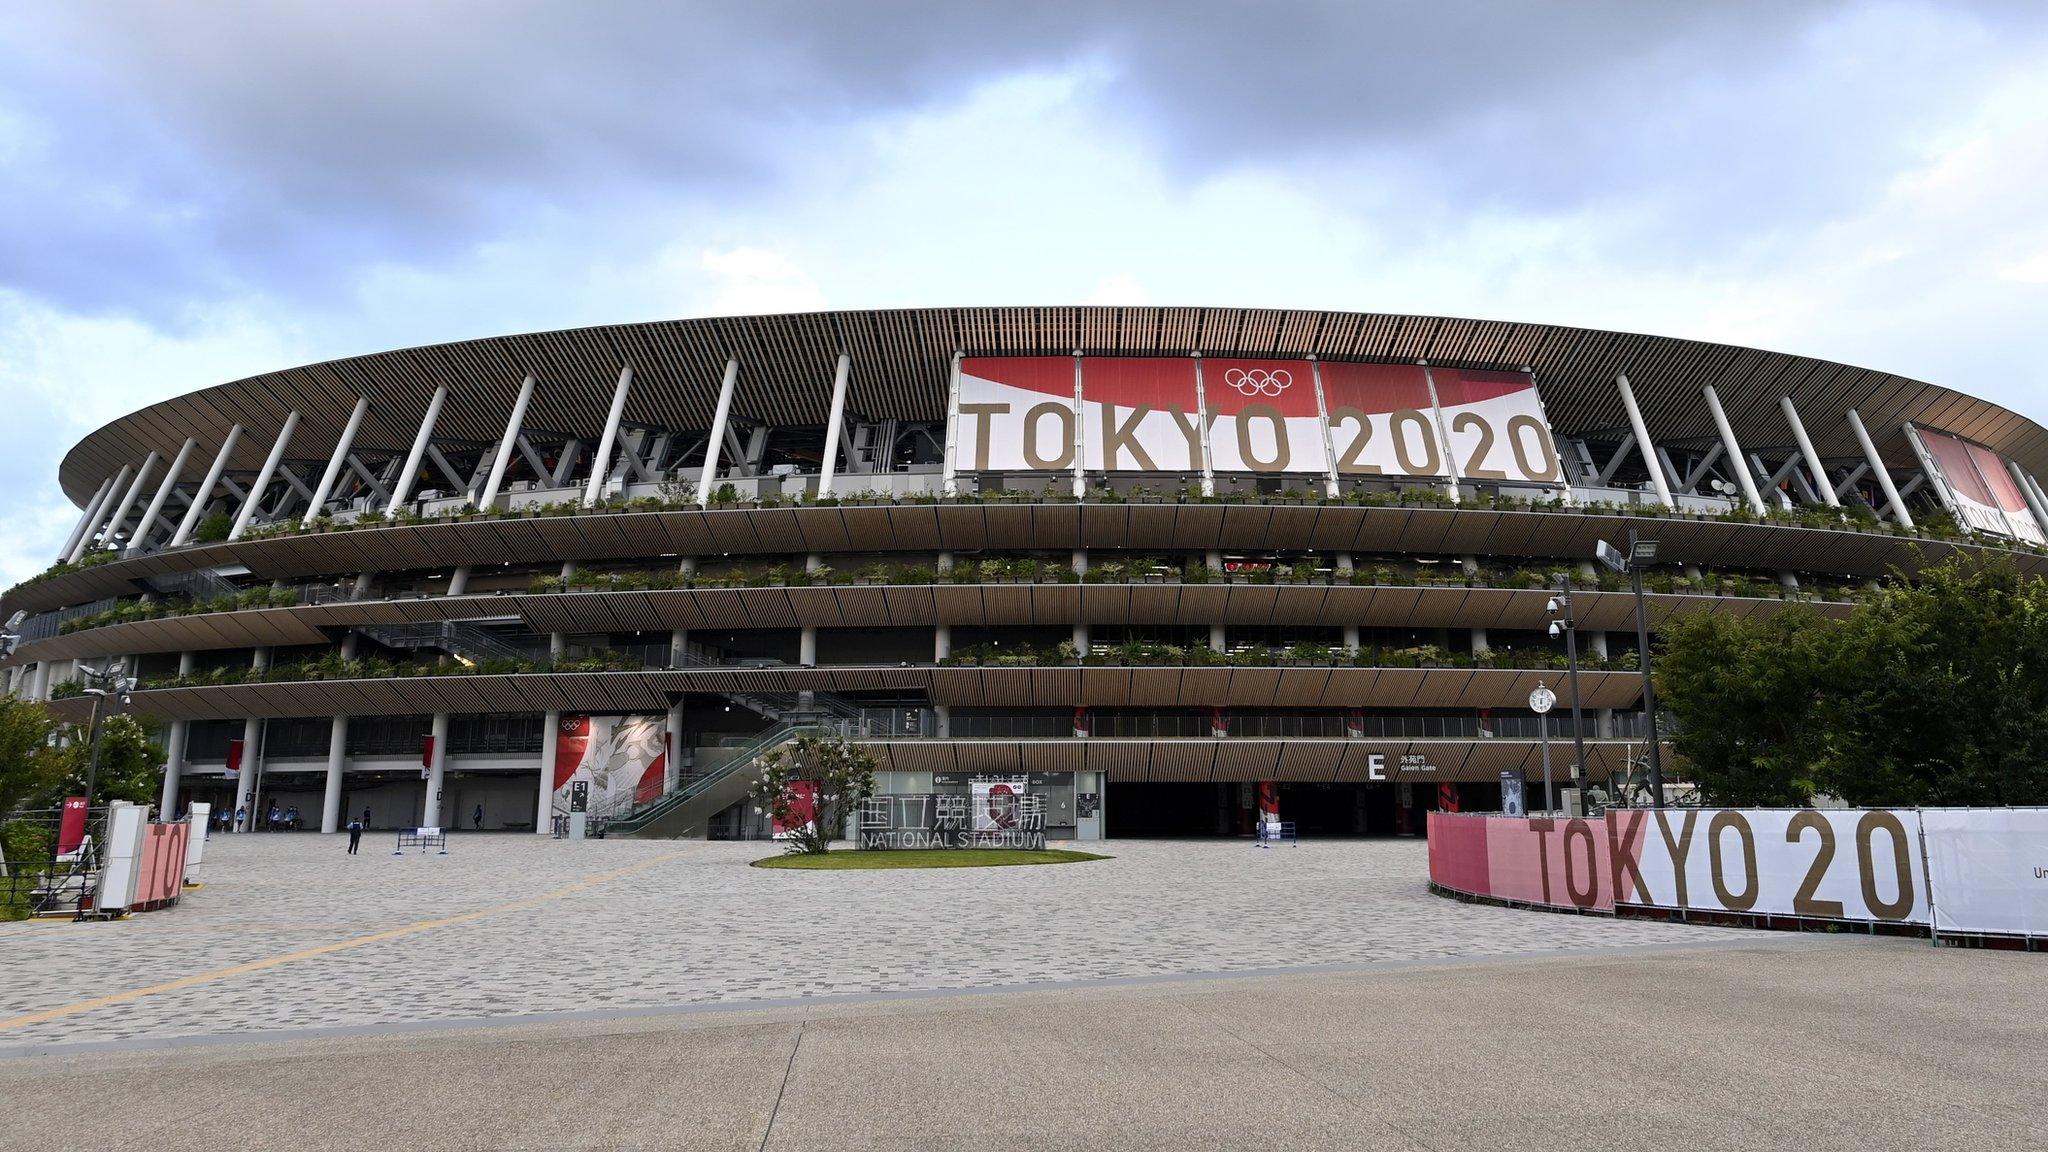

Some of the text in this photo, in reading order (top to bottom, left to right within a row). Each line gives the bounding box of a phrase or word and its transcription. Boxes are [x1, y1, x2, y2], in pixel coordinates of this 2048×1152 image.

[958, 401, 1559, 482] TOKYO 2020
[1369, 754, 1385, 779] E
[574, 782, 586, 791] E1
[861, 831, 1045, 850] NATIONAL STADIUM
[1529, 810, 1759, 911] TOKYO
